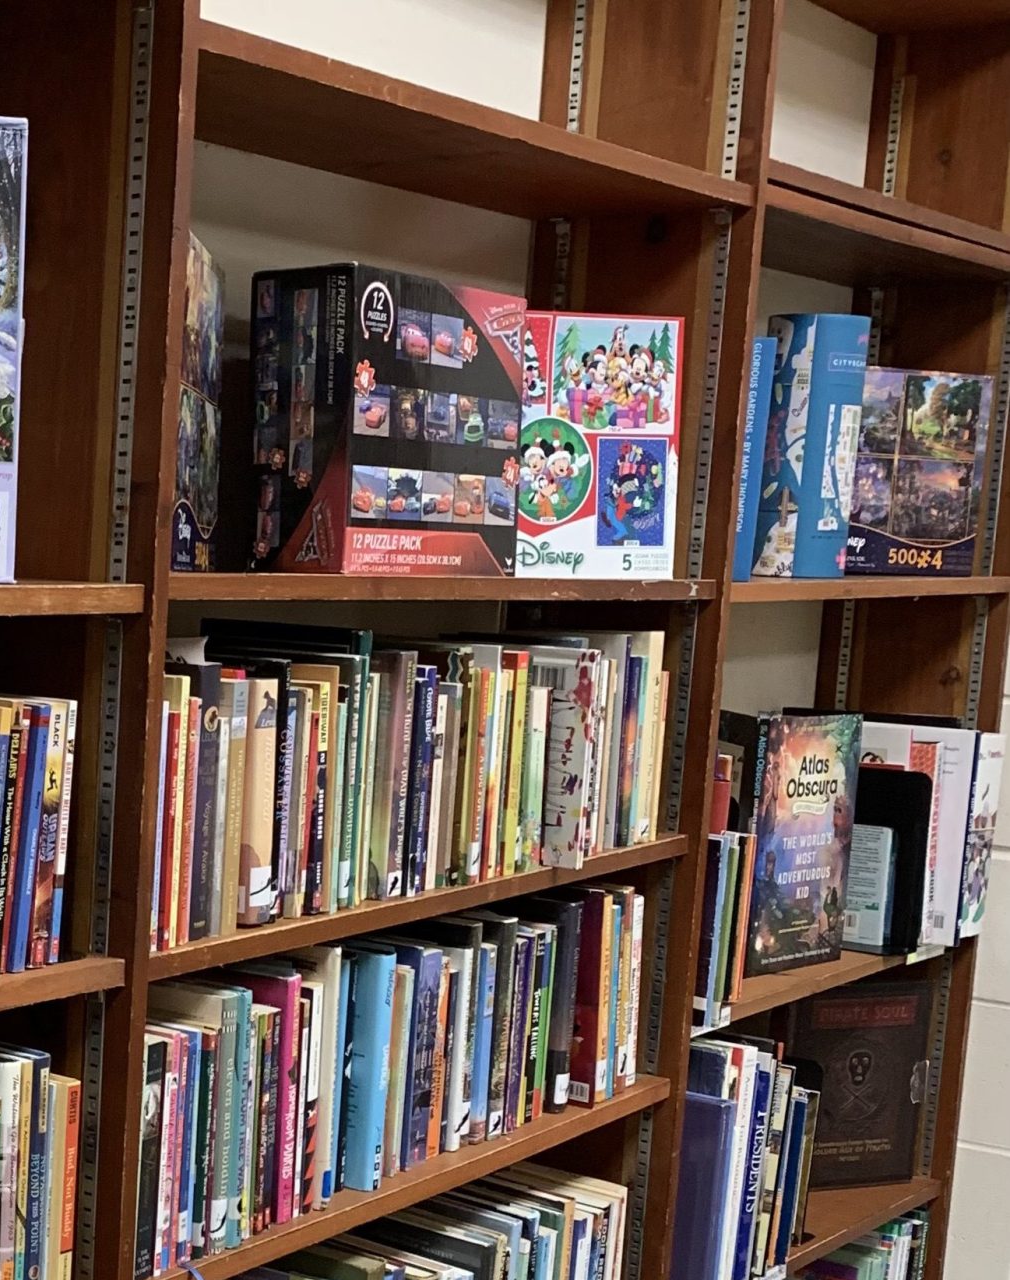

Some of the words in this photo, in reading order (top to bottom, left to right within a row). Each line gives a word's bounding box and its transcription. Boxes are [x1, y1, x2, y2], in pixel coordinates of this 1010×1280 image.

[372, 291, 384, 310] 12
[750, 343, 763, 388] GLORIOUS
[744, 389, 758, 433] GARDENS
[744, 442, 752, 454] BY
[740, 455, 750, 480] MARY
[736, 481, 748, 532] THOMPSON
[352, 533, 362, 547] 12
[364, 533, 394, 550] PUZZLE
[397, 534, 422, 551] PACK
[888, 549, 918, 565] 500
[931, 551, 942, 570] 4
[52, 714, 61, 747] BLACK
[799, 755, 829, 776] Atlas
[786, 777, 838, 799] Obscura
[783, 837, 797, 848] THE
[799, 832, 832, 846] WORLD'S
[796, 850, 817, 866] MOST
[777, 866, 831, 885] ADVENTUROUS
[796, 886, 809, 899] KID
[223, 1112, 232, 1141] and
[600, 1218, 608, 1255] EDDIE
